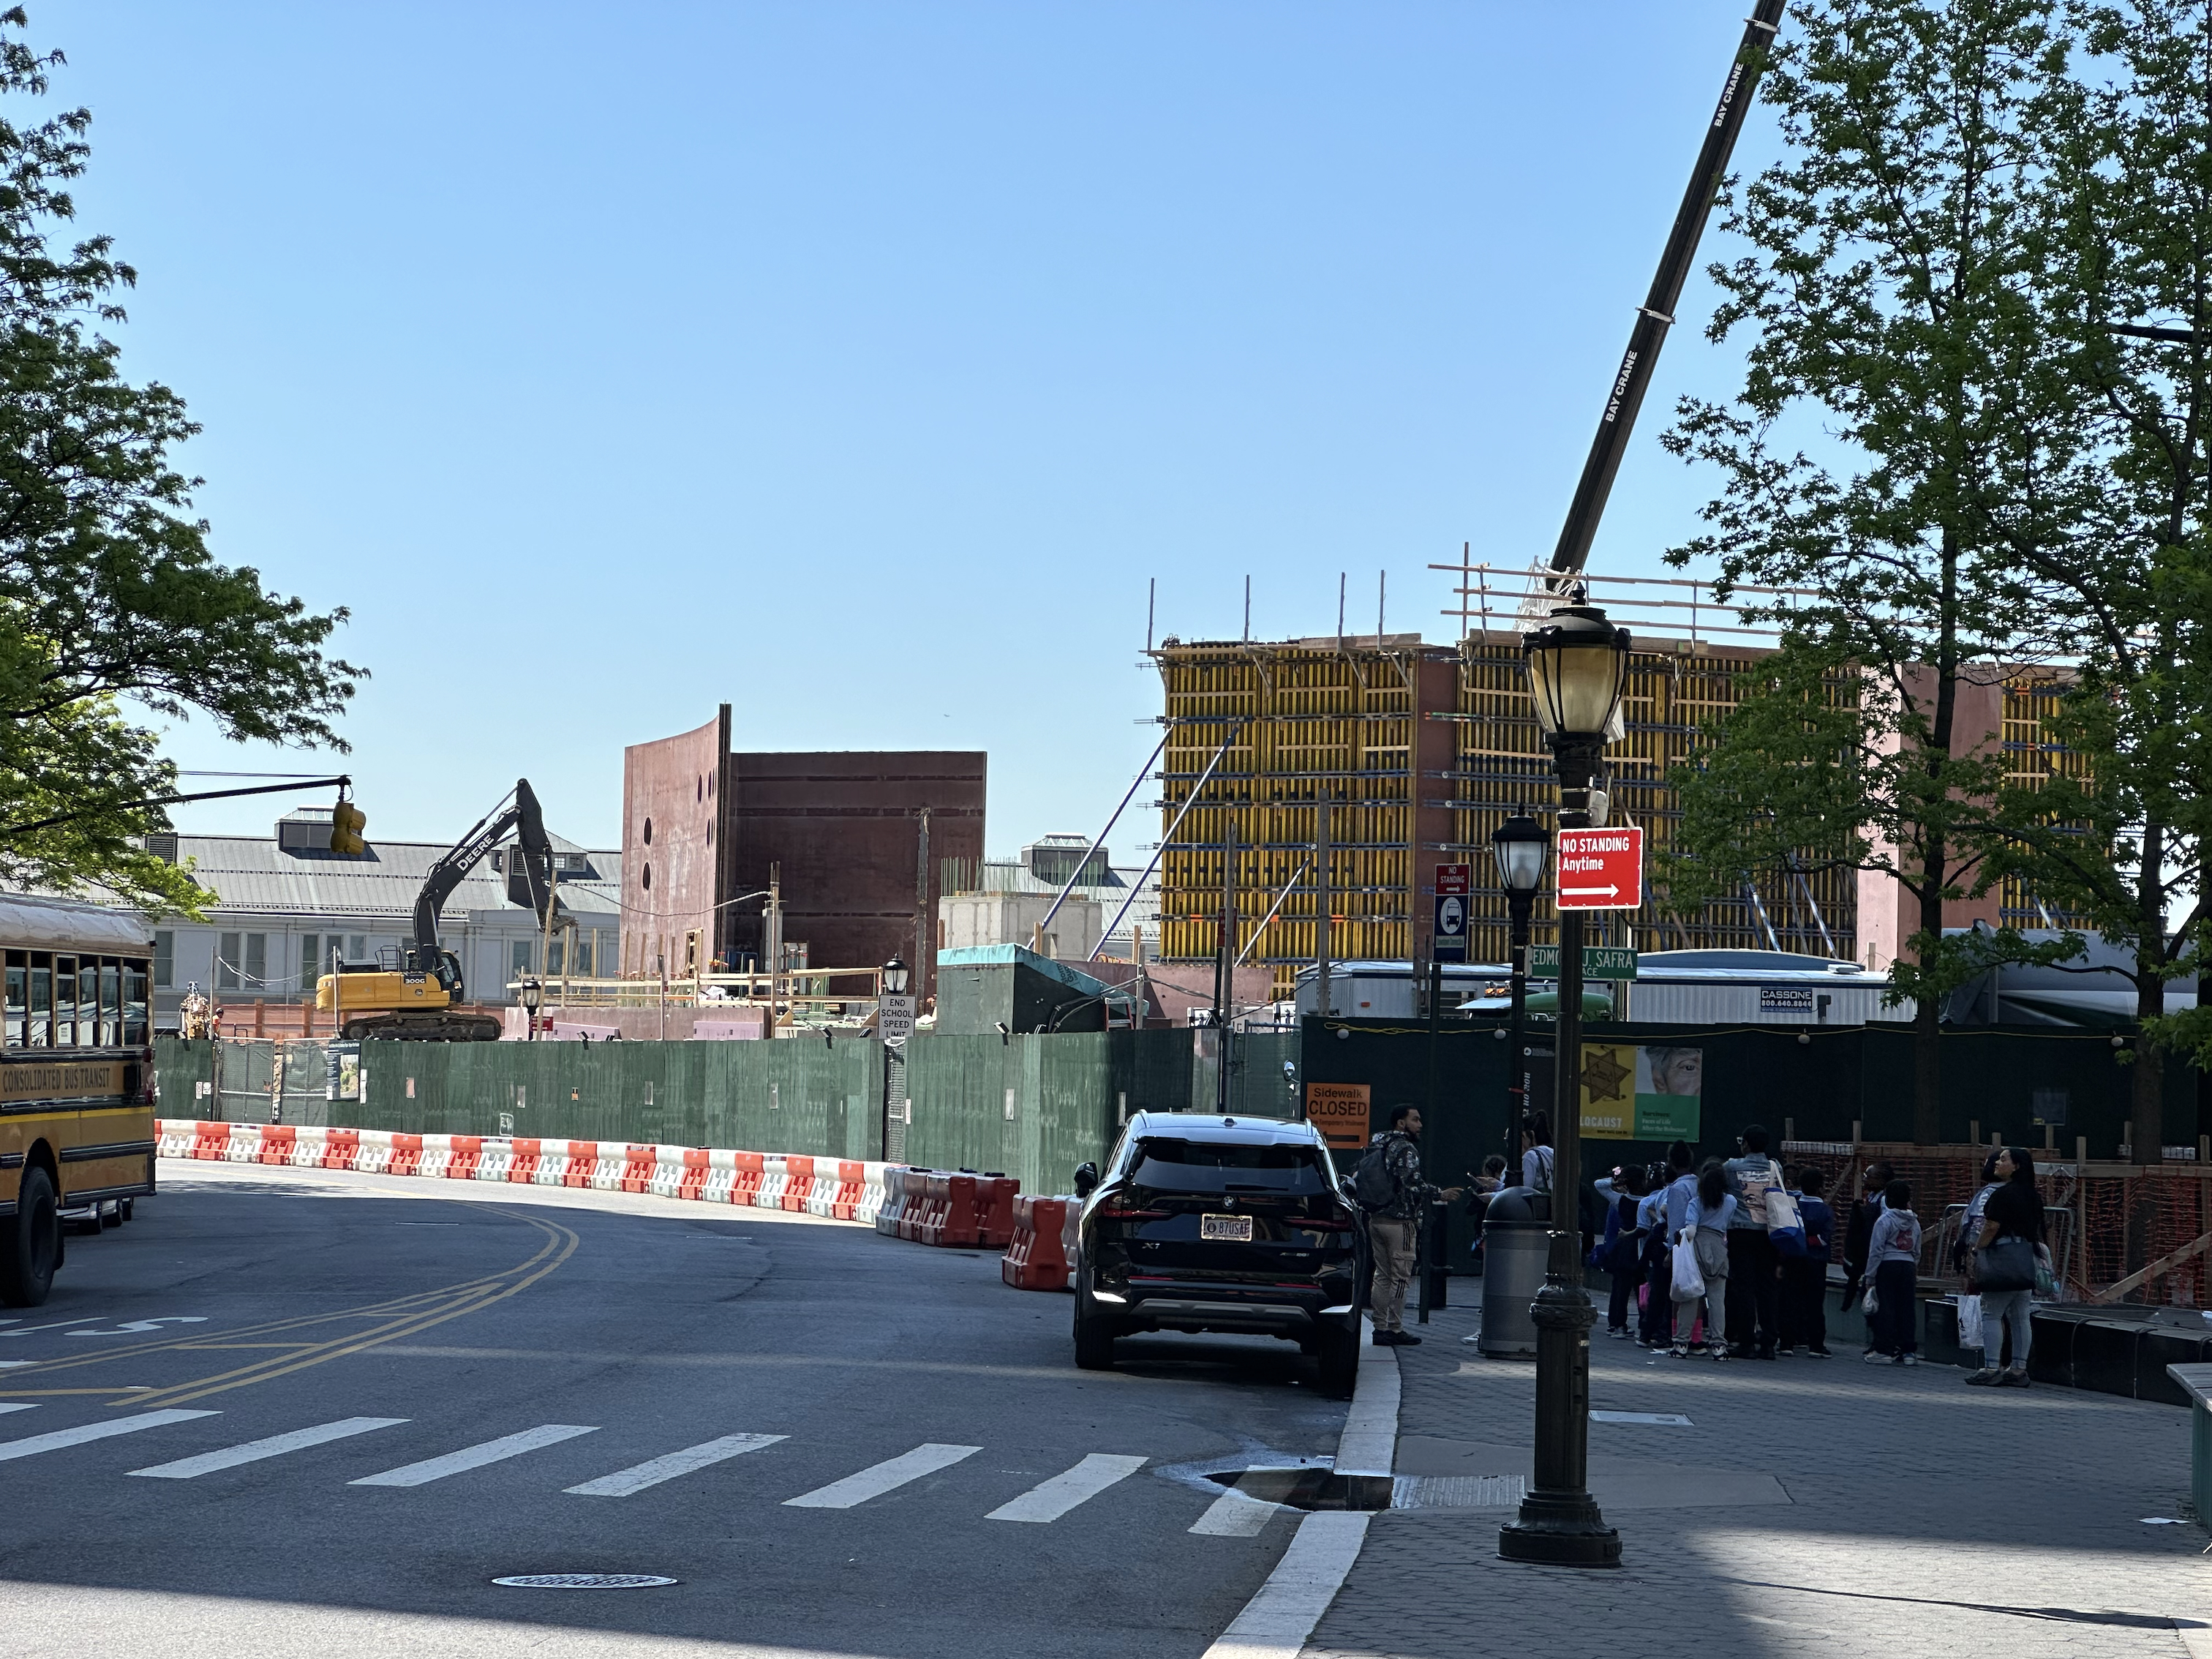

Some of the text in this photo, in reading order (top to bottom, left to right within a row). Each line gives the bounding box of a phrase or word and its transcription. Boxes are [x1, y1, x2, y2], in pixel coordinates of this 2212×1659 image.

[1714, 62, 1744, 127] BAY CRANE
[1605, 350, 1638, 422] BAY CRANE
[456, 834, 494, 871] DEERE
[1562, 837, 1630, 853] NO STANDING
[1562, 856, 1604, 873] Anytime
[1440, 866, 1465, 884] NO STANDING
[1532, 949, 1560, 966] EDM
[1596, 951, 1633, 968] SAFRA
[1582, 967, 1598, 977] ACE
[889, 998, 906, 1007] END
[1761, 990, 1812, 1000] CASSONE
[881, 1009, 913, 1018] SCHOOL
[884, 1020, 909, 1028] SPEED
[3, 1067, 110, 1092] CONSOLIDATED BUS TRANSIT
[1314, 1087, 1363, 1098] Sidewalk
[1309, 1100, 1367, 1116] CLOSED
[1580, 1116, 1622, 1128] LOCAUST
